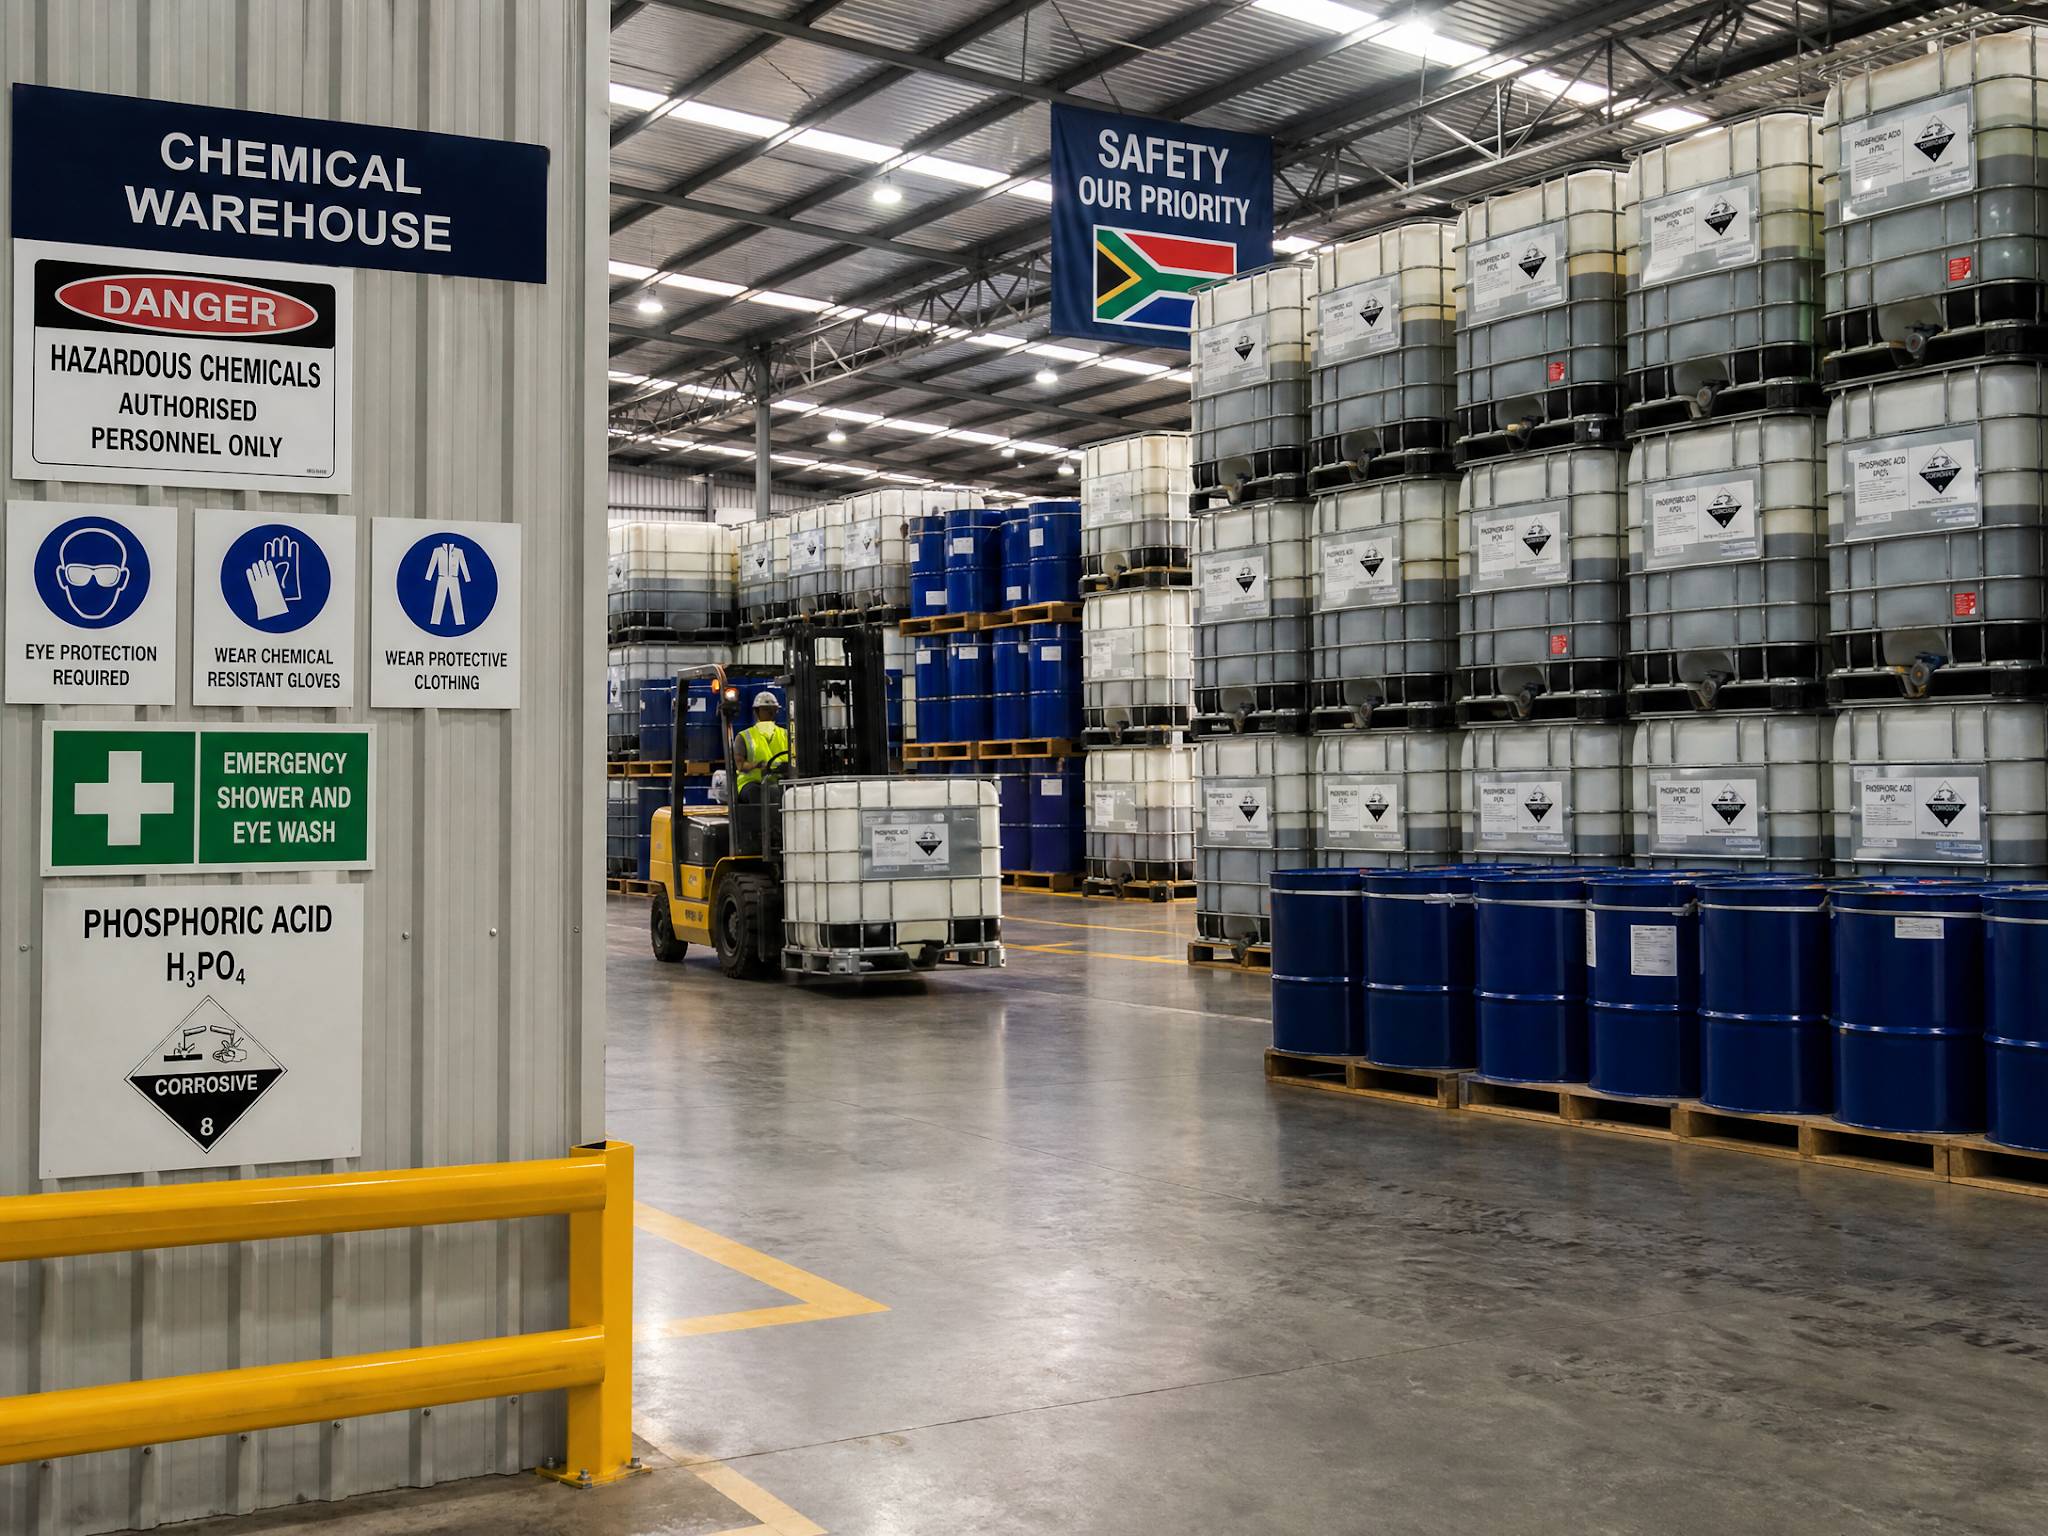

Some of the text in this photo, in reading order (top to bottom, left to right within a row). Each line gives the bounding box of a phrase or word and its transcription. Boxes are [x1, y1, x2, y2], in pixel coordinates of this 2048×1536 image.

[161, 133, 421, 194] CHEMICAL
[1099, 129, 1228, 184] SAFETY
[1079, 176, 1250, 225] OUR PRIORITY
[125, 185, 451, 251] WAREHOUSE
[104, 285, 276, 326] DANGER
[52, 344, 320, 388] HAZARDOUS CHEMICALS
[119, 393, 256, 421] AUTHORISED
[92, 427, 282, 457] PERSONNEL ONLY
[26, 644, 156, 661] EYE PROTECTION
[215, 648, 333, 664] WEAR CHEMICAL
[386, 651, 507, 667] WEAR PROTECTIVE
[54, 670, 129, 685] REQUIRED
[208, 672, 340, 688] RESISTANT GLOVES
[415, 675, 479, 690] CLOTHING
[224, 752, 347, 774] EMERGENCY
[217, 787, 351, 809] SHOWER AND
[234, 821, 335, 843] EYE WASH
[85, 905, 331, 938] PHOSPHORIC ACID
[155, 1074, 257, 1096] CORROSIVE
[201, 1118, 213, 1135] 8
